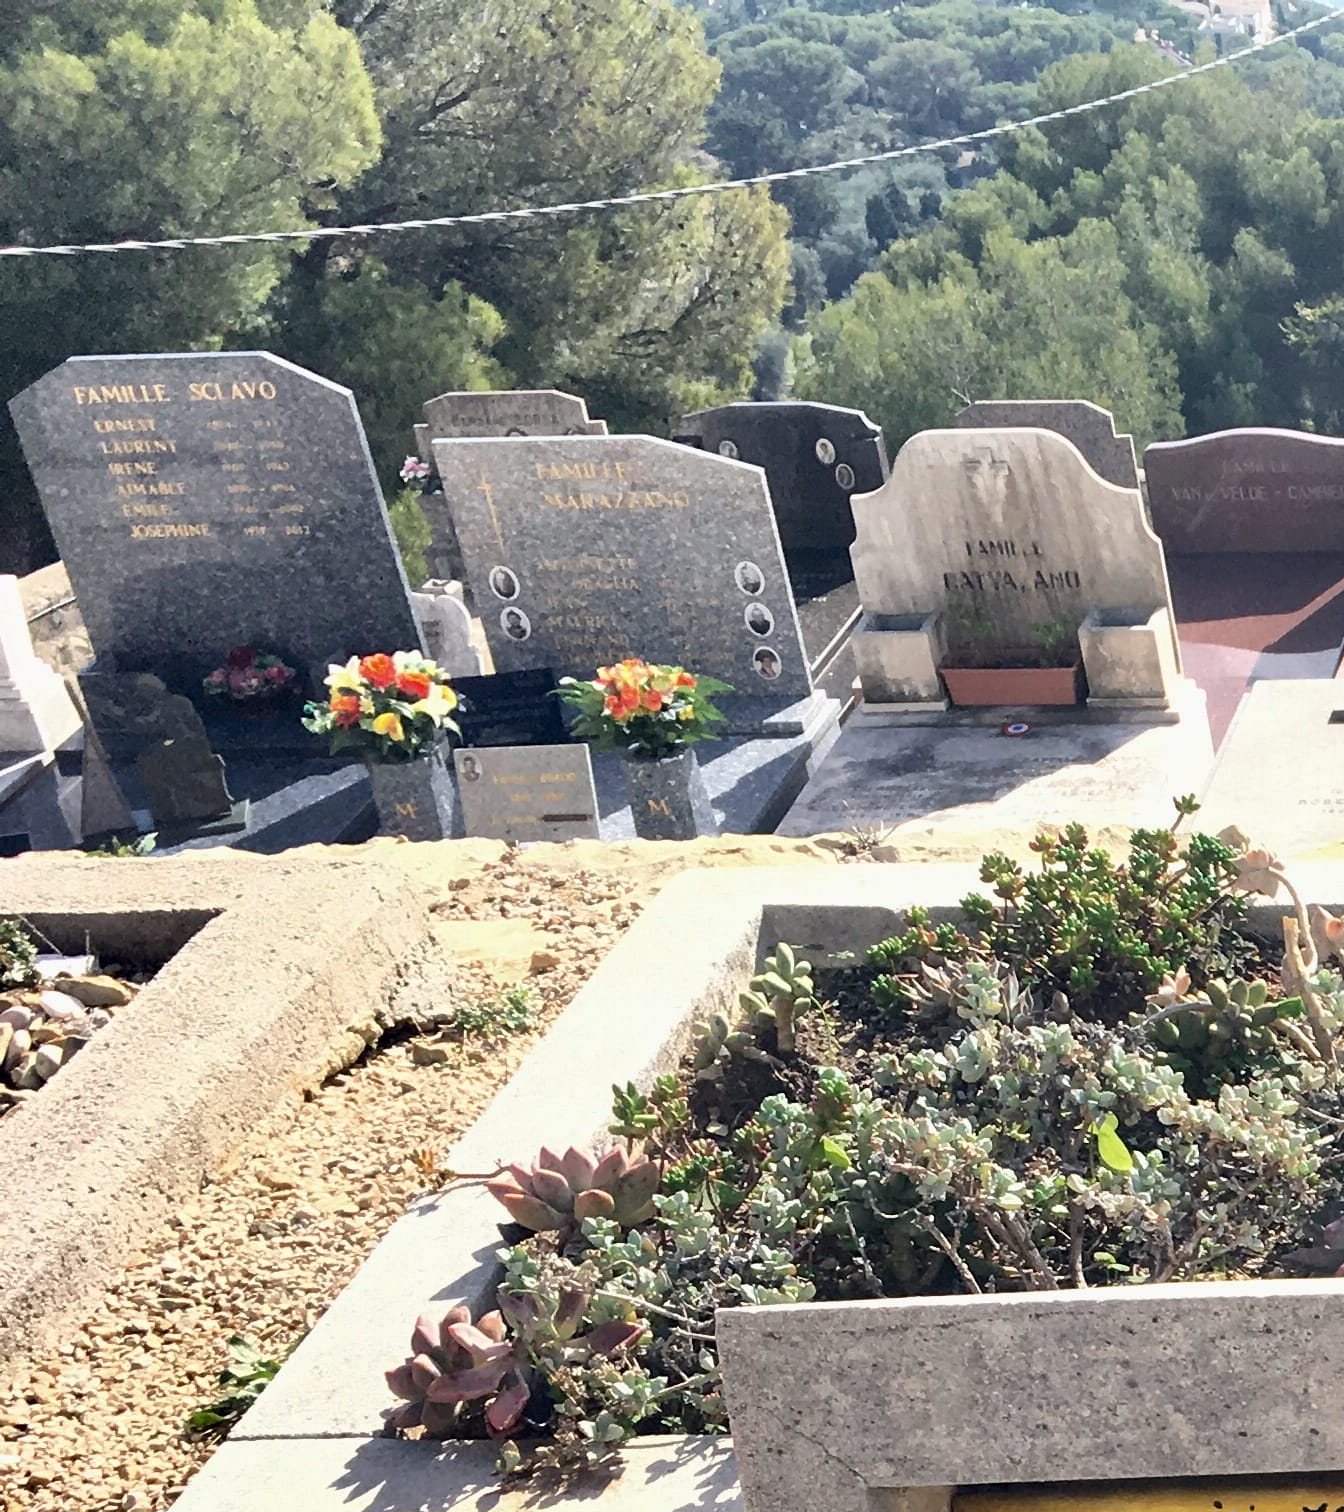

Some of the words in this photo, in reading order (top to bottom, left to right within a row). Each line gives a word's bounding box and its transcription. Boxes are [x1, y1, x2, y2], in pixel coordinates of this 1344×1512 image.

[73, 384, 171, 405] FAMILLE
[188, 381, 277, 400] SCLAVO
[93, 418, 157, 432] ERNEST
[100, 439, 177, 455] LAURENT
[536, 462, 625, 479] FAMILLE
[130, 523, 211, 538] JOSEPHINE
[647, 799, 672, 818] M
